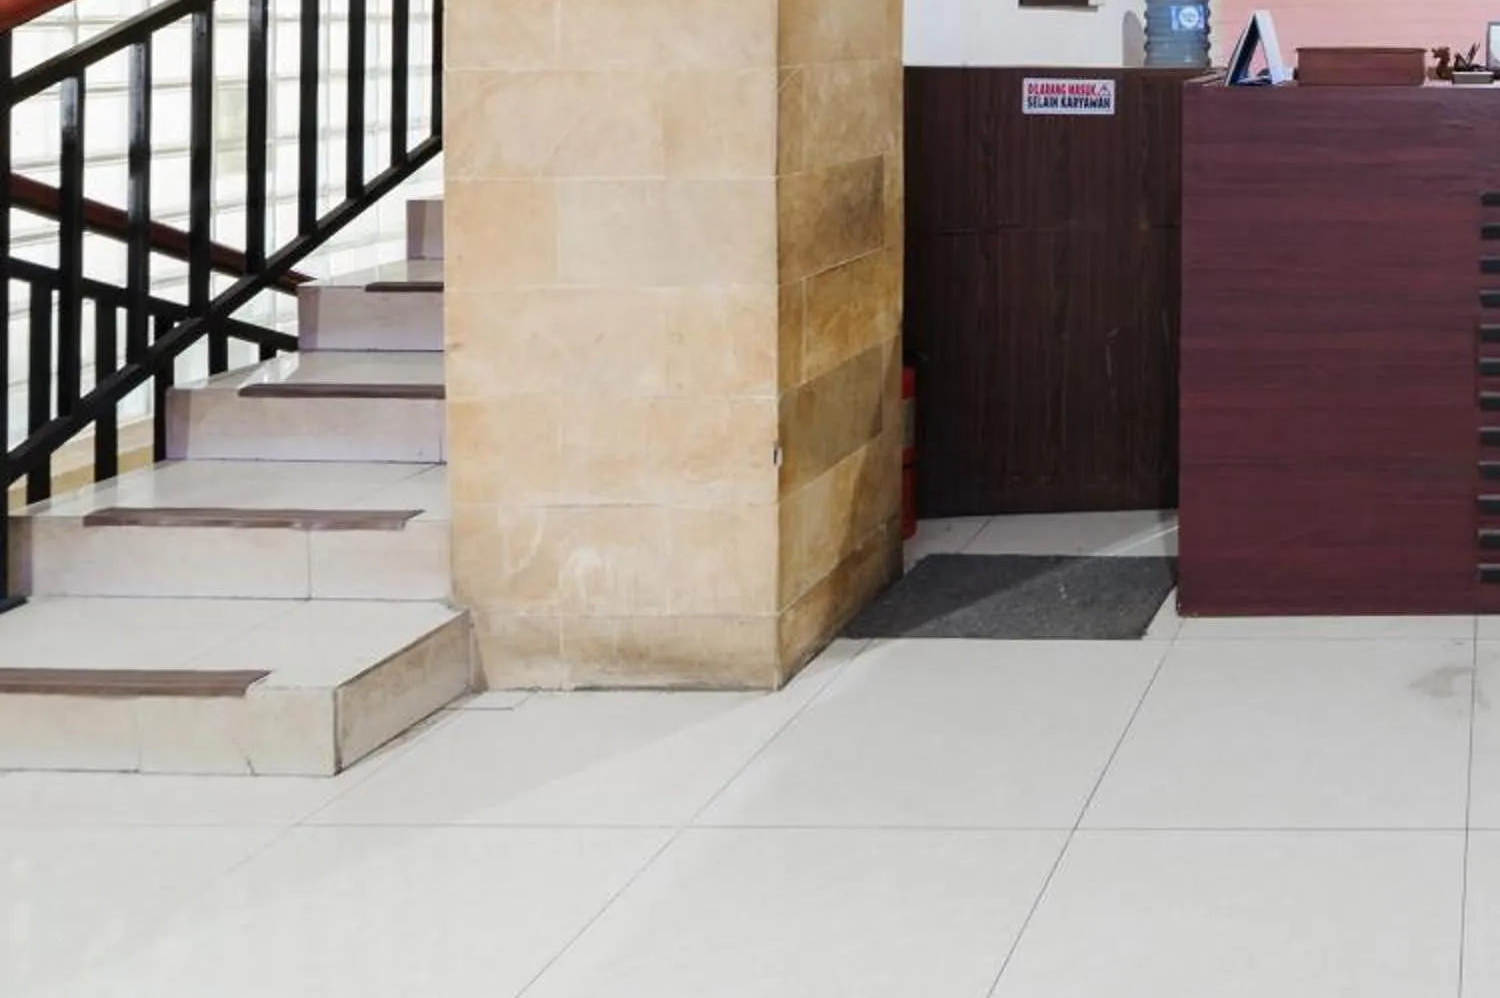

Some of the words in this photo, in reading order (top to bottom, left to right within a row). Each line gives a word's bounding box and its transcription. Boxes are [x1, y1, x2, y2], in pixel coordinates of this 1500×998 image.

[1028, 83, 1066, 95] DILARANG
[1067, 83, 1096, 95] MASUK
[1027, 96, 1058, 108] SELAIN
[1061, 96, 1110, 108] KARYAWAN
